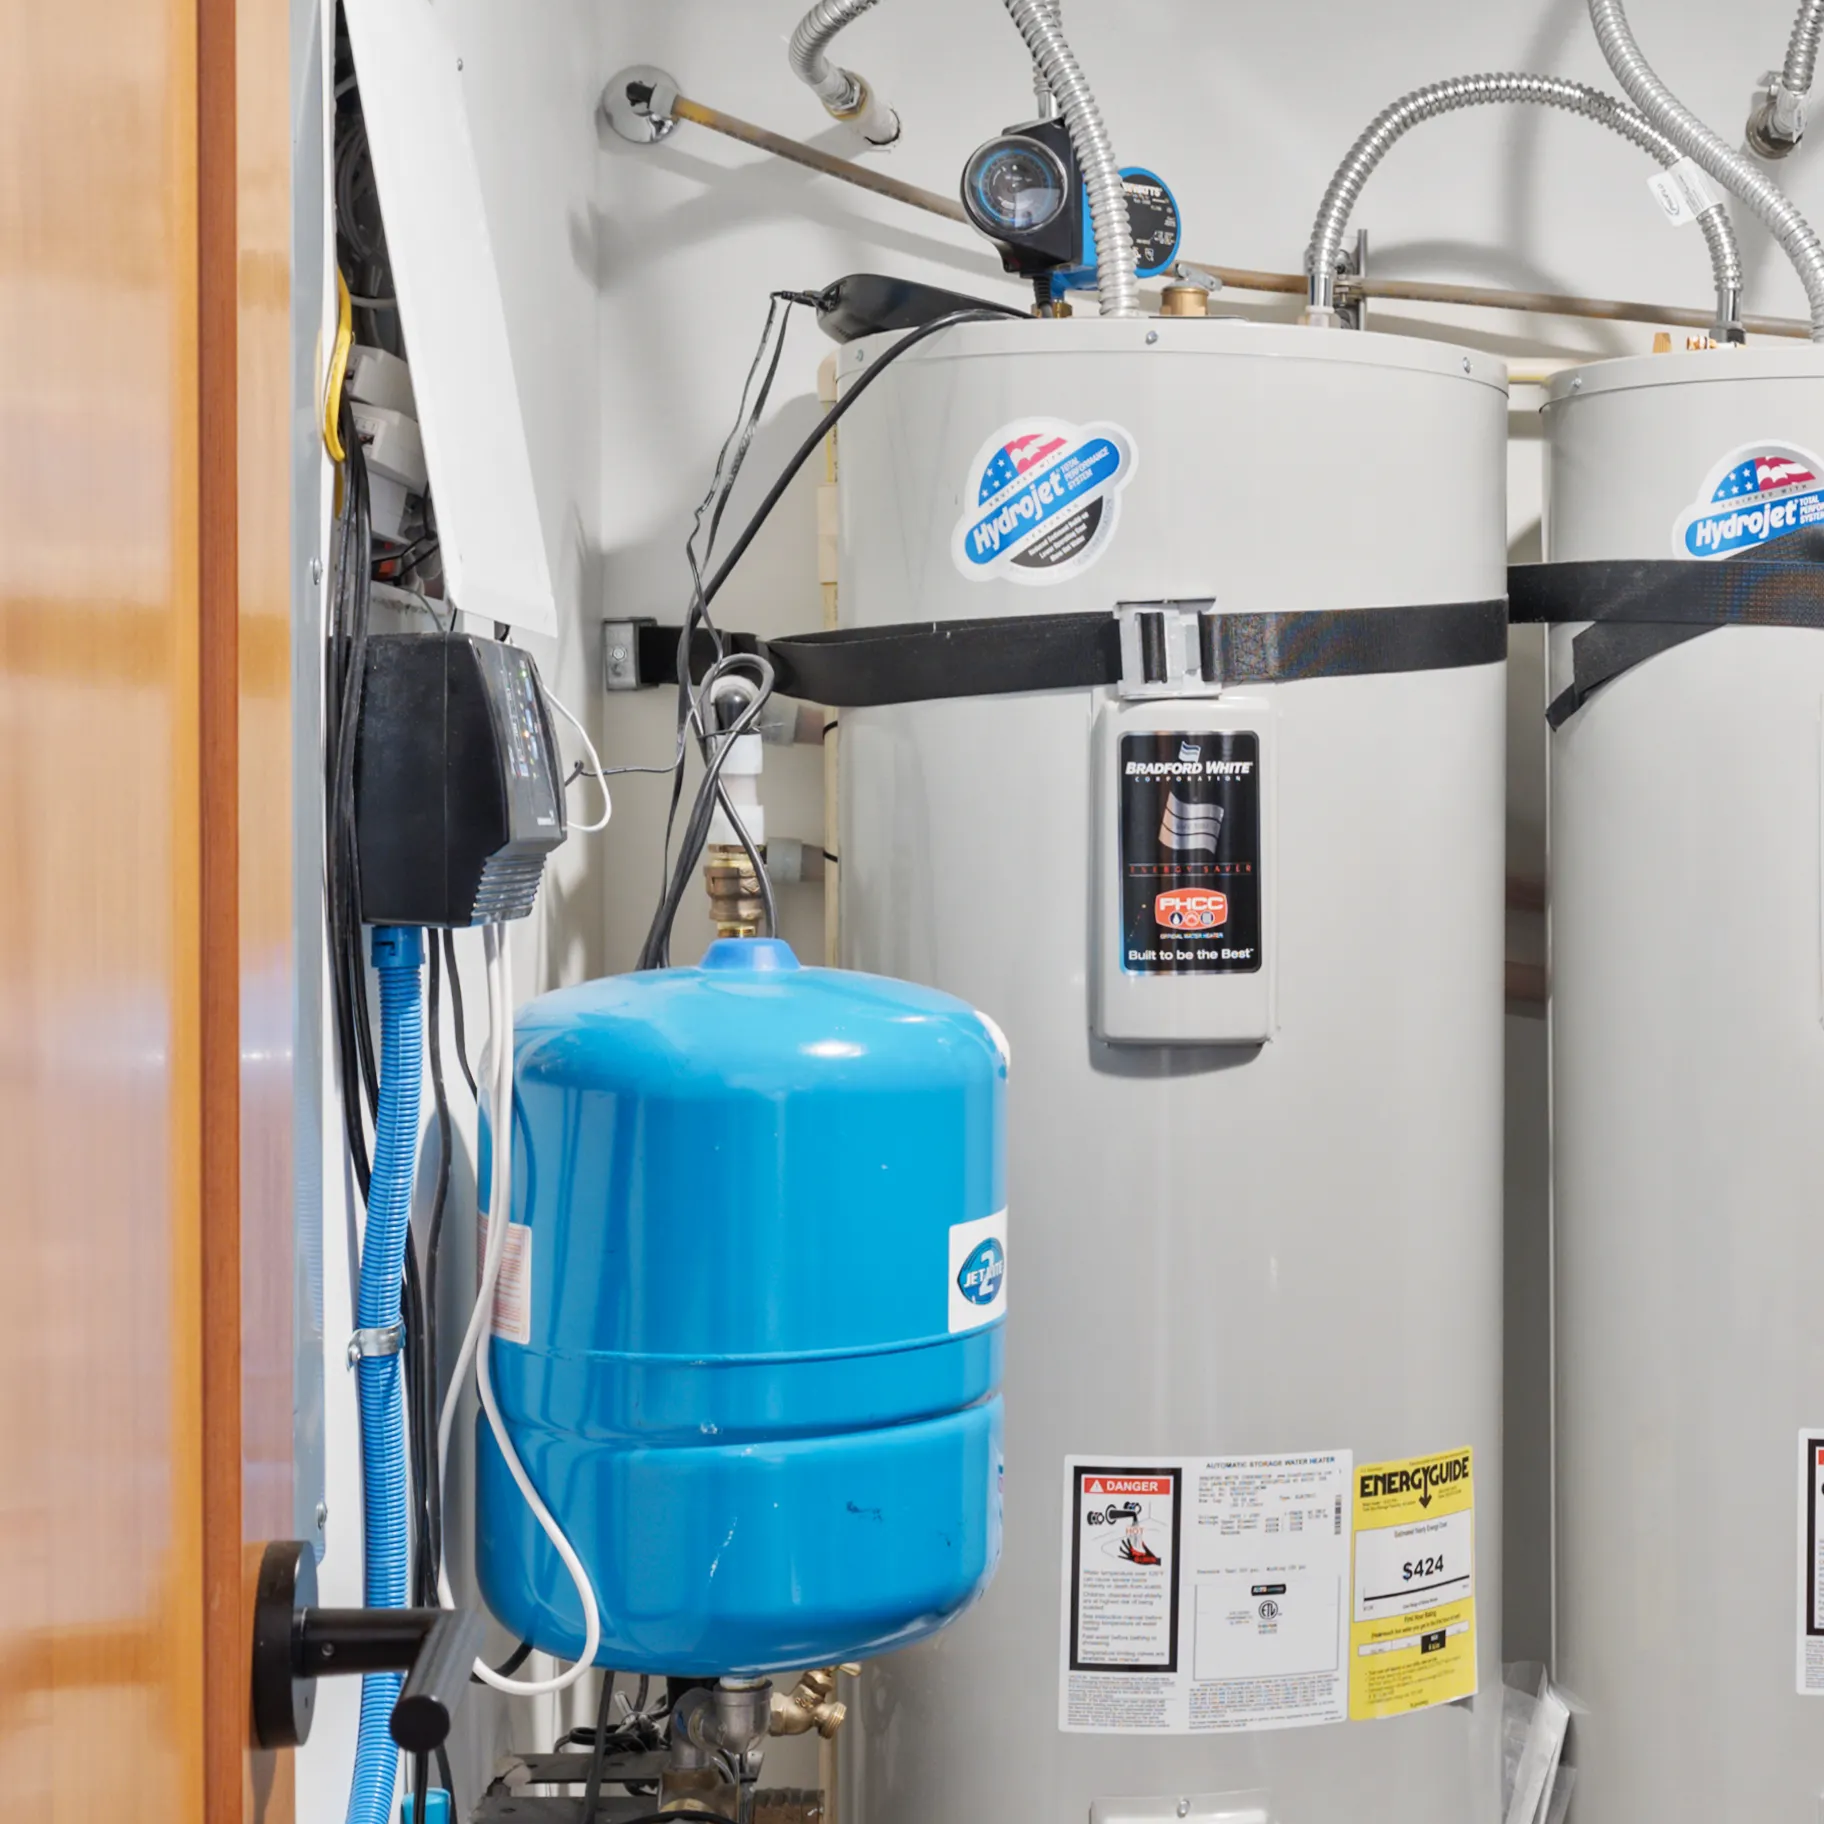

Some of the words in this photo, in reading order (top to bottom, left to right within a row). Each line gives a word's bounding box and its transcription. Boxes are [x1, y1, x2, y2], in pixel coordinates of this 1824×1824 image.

[1799, 495, 1819, 506] TOTAL
[972, 469, 1065, 555] Hydrojet
[1696, 500, 1797, 550] Hydrojet
[1125, 761, 1203, 775] BRADFORD
[1206, 760, 1251, 774] WHITE
[1134, 775, 1241, 783] CORPORATION
[1130, 864, 1193, 874] ENERGY
[1203, 863, 1252, 873] SAVER
[1160, 897, 1224, 911] PHCC
[1128, 950, 1157, 960] Built
[1159, 950, 1173, 960] to
[1176, 950, 1194, 960] be
[1196, 949, 1218, 960] the
[1221, 948, 1252, 959] Best
[1249, 1460, 1282, 1468] STORAGE
[1309, 1456, 1335, 1464] HEATER
[1360, 1455, 1469, 1498] ENERGYGUIDE
[1106, 1480, 1158, 1492] DANGER
[1125, 1527, 1145, 1535] HOT
[1403, 1554, 1445, 1582] $424
